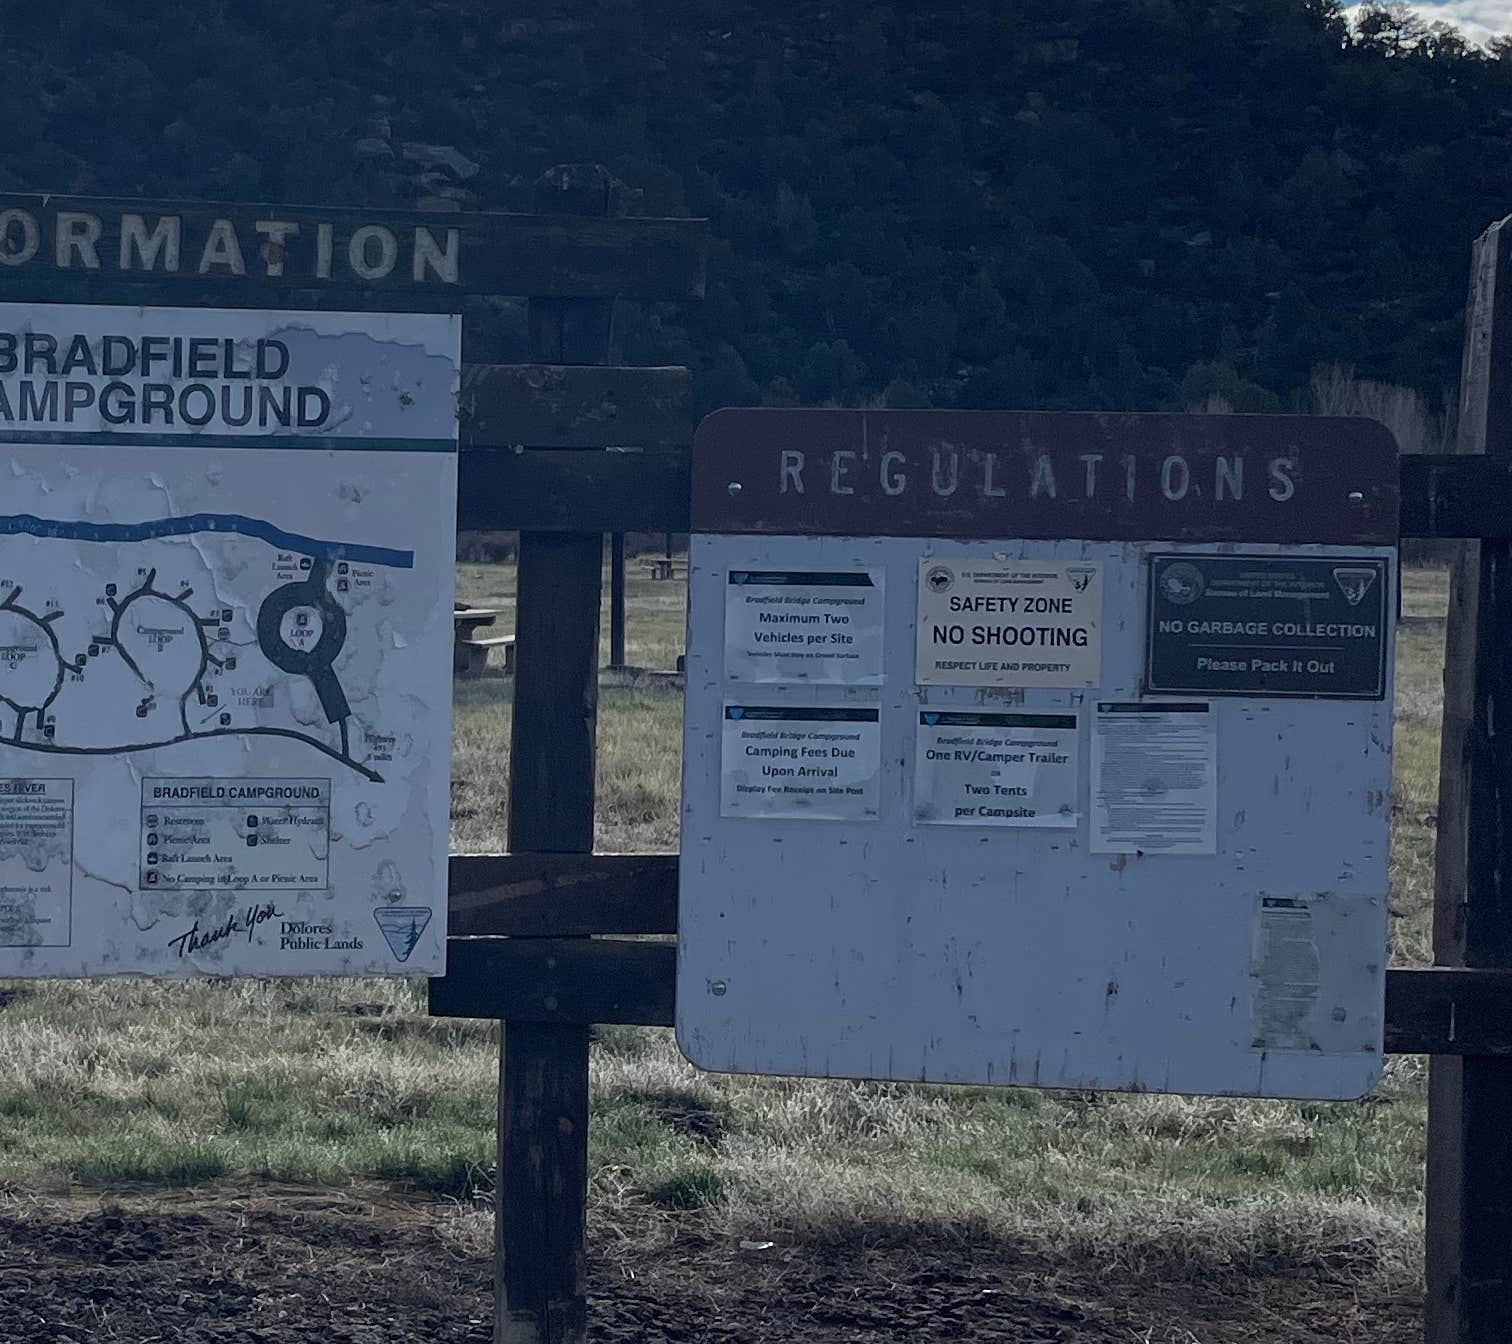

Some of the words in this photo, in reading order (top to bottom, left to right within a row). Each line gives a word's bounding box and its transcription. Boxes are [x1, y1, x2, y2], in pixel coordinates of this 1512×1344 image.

[780, 450, 1296, 502] REGULATIONS
[950, 597, 1018, 612] SAFETY
[1024, 598, 1072, 613] ZONE
[760, 613, 820, 623] Maximum
[824, 614, 849, 624] Two
[933, 625, 964, 644] NO
[972, 627, 1087, 646] SHOOTING
[1160, 621, 1182, 633] NO
[1188, 621, 1268, 635] GARBAGE
[1272, 623, 1375, 637] COLLECTION
[754, 632, 803, 643] Vehicles
[807, 635, 827, 645] per
[831, 633, 853, 644] Site
[936, 661, 976, 670] RESPECT
[979, 662, 998, 670] LIFE
[1001, 663, 1019, 671] AND
[1022, 663, 1070, 672] PROPERTY
[1197, 658, 1246, 671] Please
[1251, 659, 1288, 672] Pack
[1307, 661, 1334, 673] Out
[746, 746, 797, 759] Camping
[802, 747, 828, 757] Fees
[832, 747, 855, 757] Due
[926, 750, 950, 759] One
[955, 750, 1025, 764] RV/Camper
[1029, 753, 1068, 763] Trailer
[762, 766, 794, 777] Upon
[798, 766, 837, 777] Arrival
[154, 787, 225, 798] BRADFIELD
[229, 787, 319, 799] CAMPGROUND
[965, 784, 990, 794] Two
[994, 785, 1027, 796] Tents
[955, 808, 975, 817] per
[979, 807, 1035, 817] Campsite
[164, 817, 204, 825] Restroom
[162, 855, 179, 863] Raft
[182, 855, 212, 863] Launch
[168, 915, 247, 957] Thank
[246, 904, 284, 942] You
[280, 922, 332, 934] Dolores
[280, 937, 320, 950] Public
[324, 938, 363, 950] Lands
